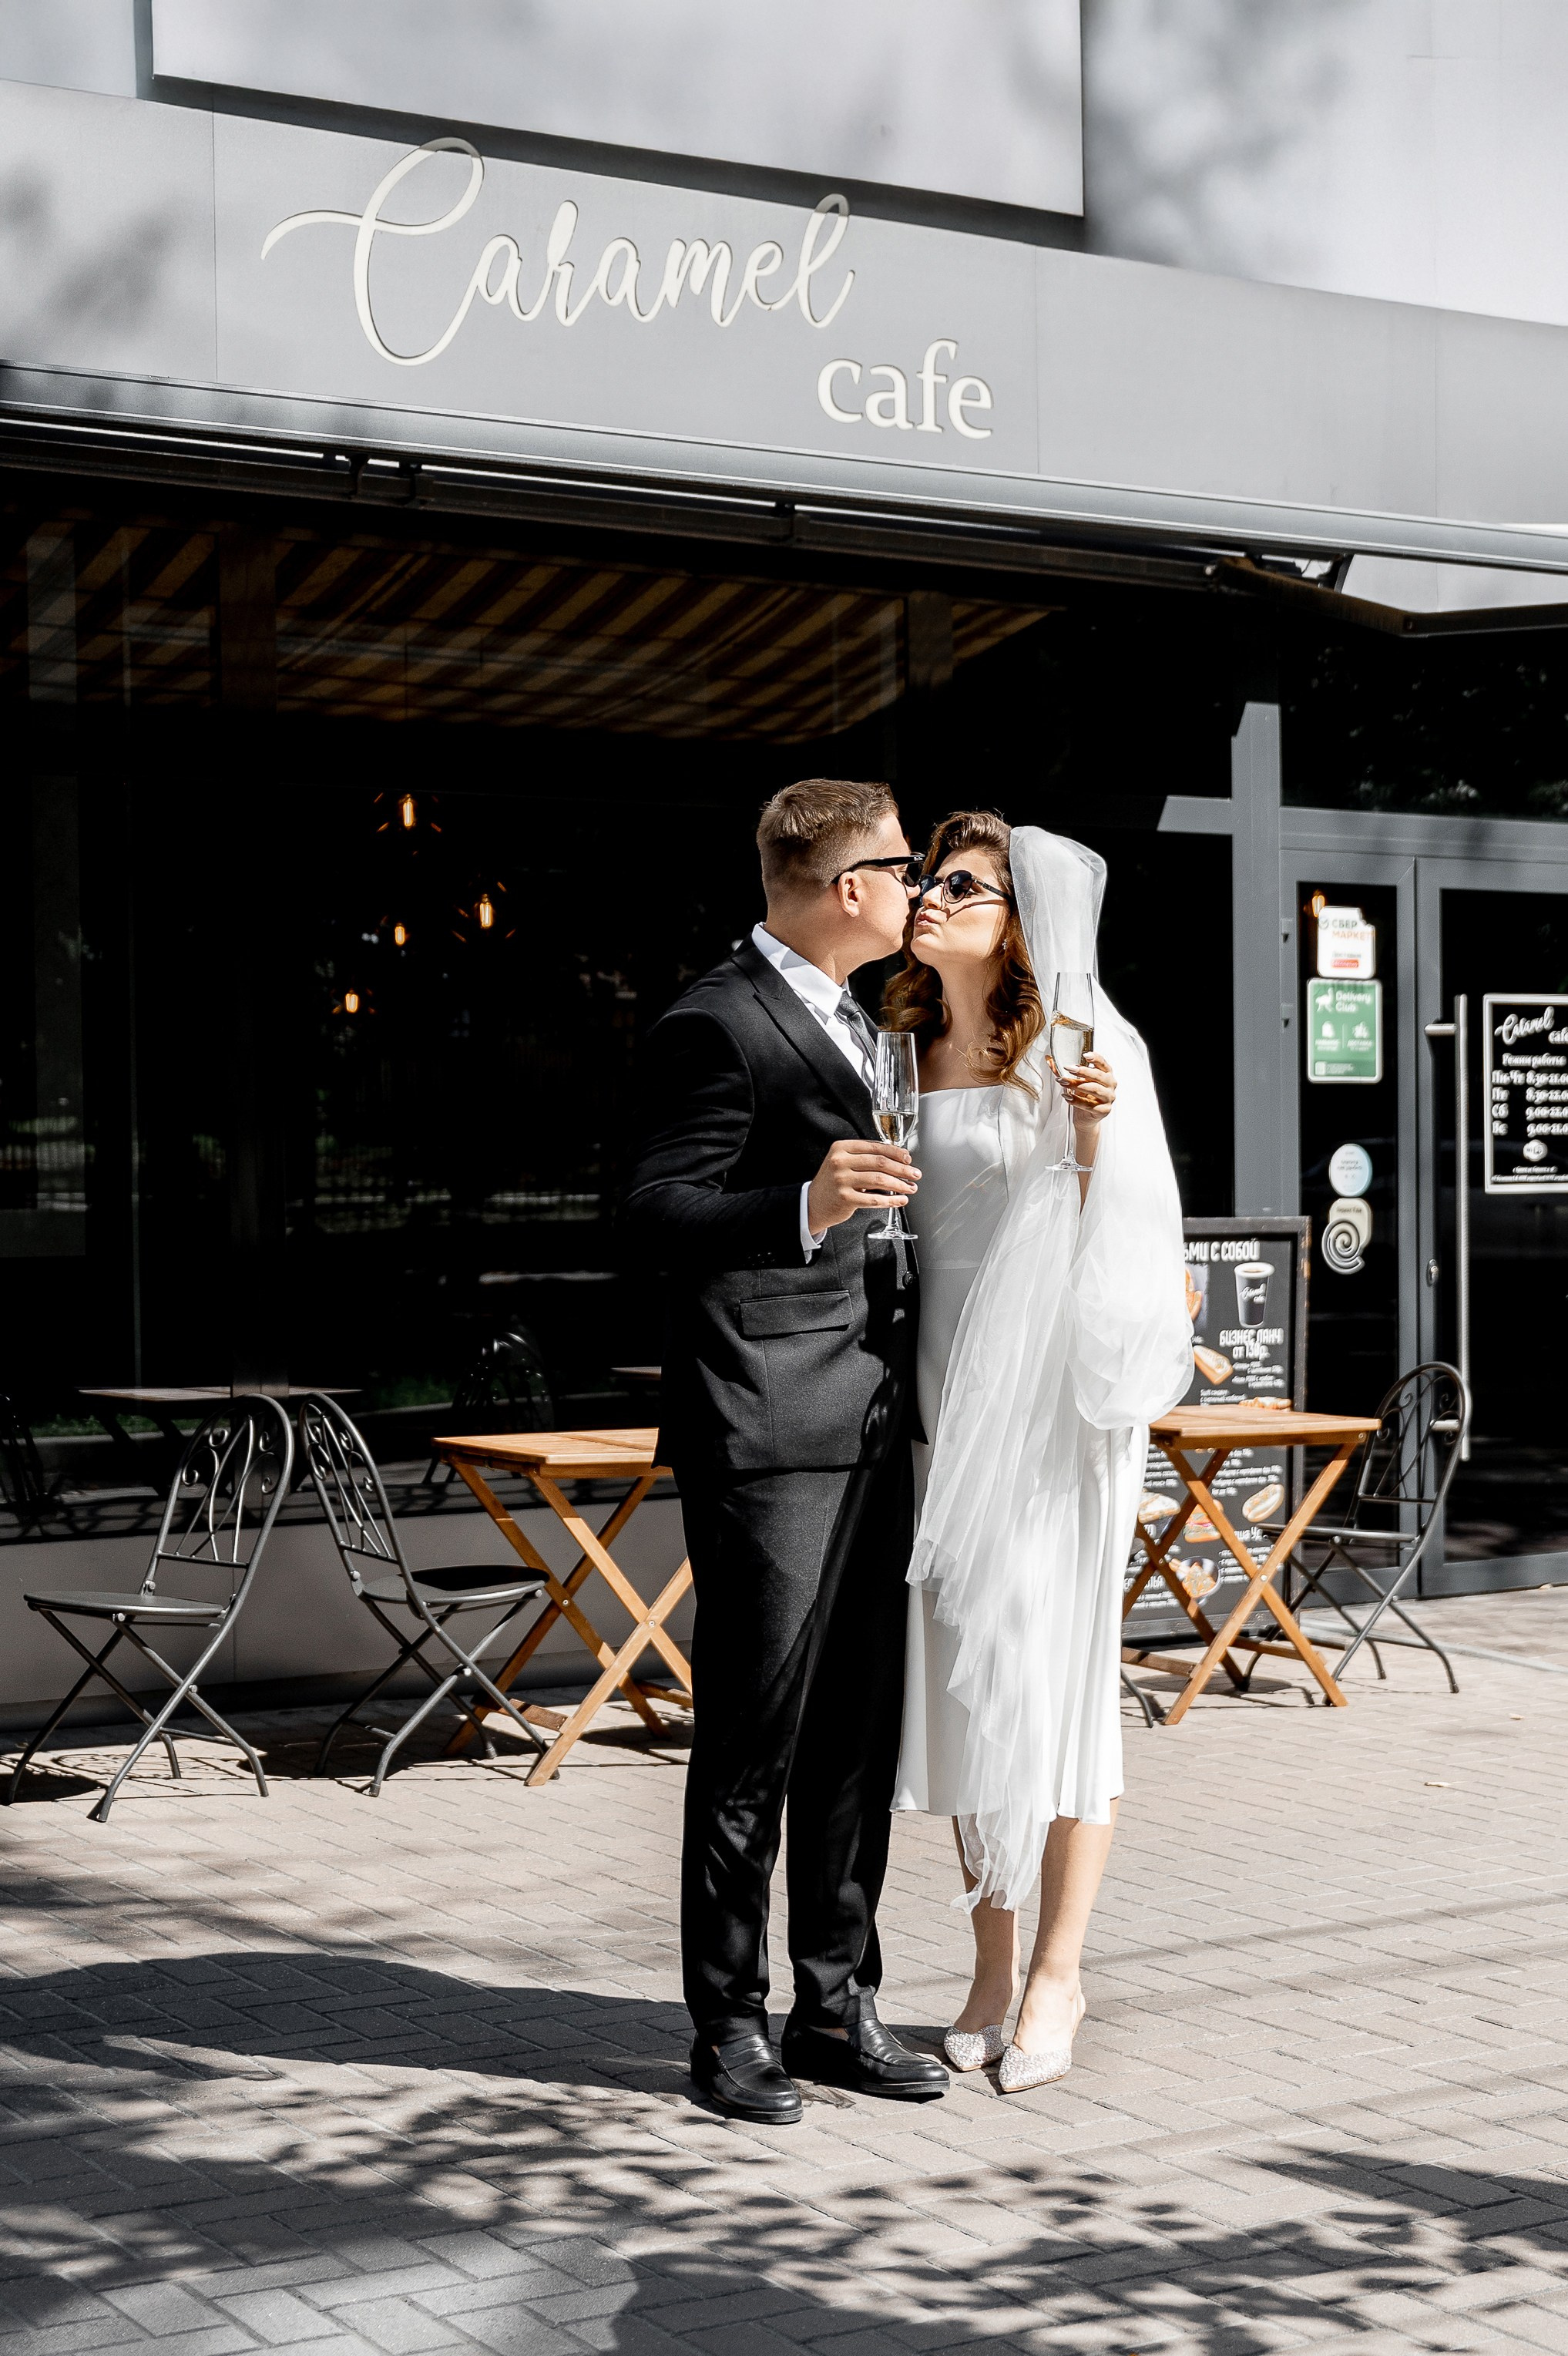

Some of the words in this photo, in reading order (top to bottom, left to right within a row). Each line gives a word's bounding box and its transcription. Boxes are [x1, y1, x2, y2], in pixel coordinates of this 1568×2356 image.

[260, 136, 855, 367] Caramel
[816, 338, 994, 440] cafe
[1335, 990, 1372, 1005] Delivery
[1335, 1002, 1357, 1013] Club
[1526, 1070, 1568, 1088] 8.30-21.0
[1526, 1087, 1568, 1104] 8.30-22.0
[1526, 1106, 1568, 1121] 9.00-22.0
[1527, 1123, 1568, 1138] 9.00-21.0
[1184, 1241, 1209, 1262] ЬМИ
[1210, 1241, 1220, 1262] С
[1221, 1238, 1261, 1262] СОБОЙ
[1220, 1329, 1256, 1347] БИЗНЕС
